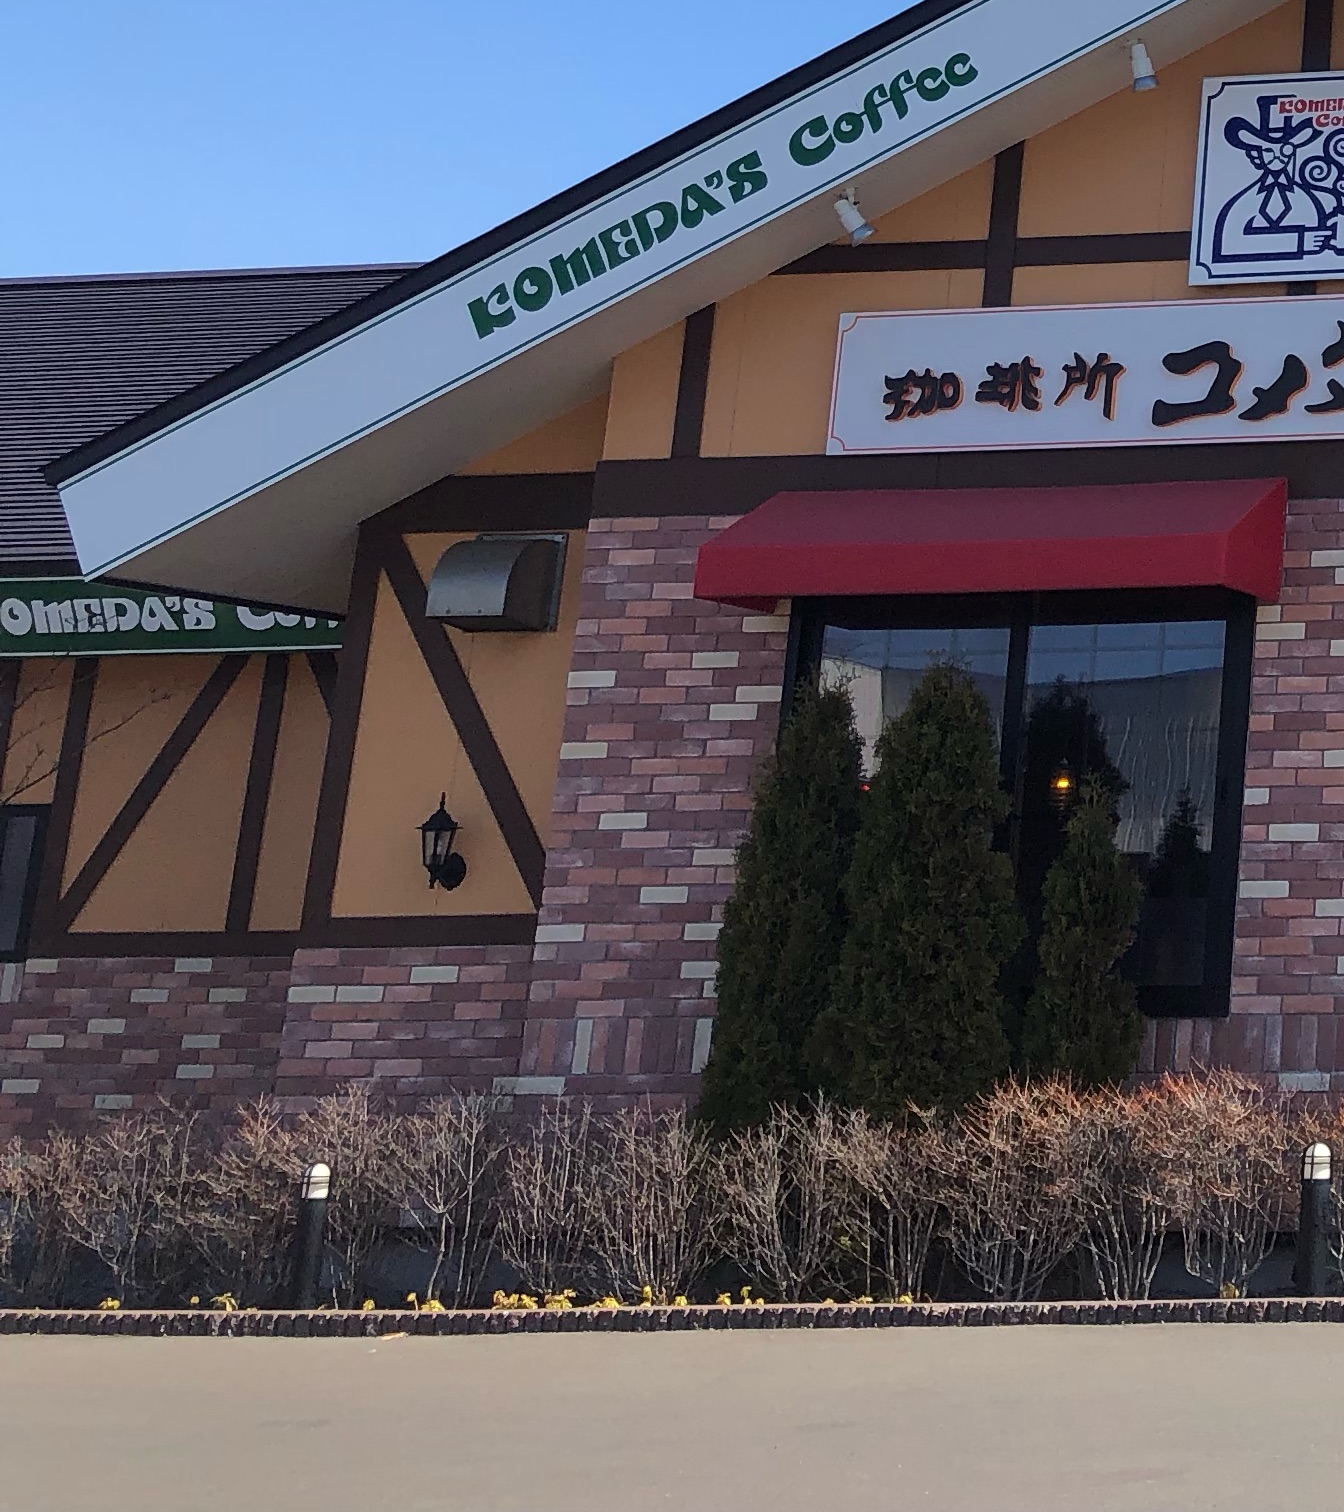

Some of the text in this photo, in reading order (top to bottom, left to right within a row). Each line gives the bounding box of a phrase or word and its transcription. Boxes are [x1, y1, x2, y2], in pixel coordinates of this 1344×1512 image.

[466, 51, 979, 340] KOMEDA'S Coffee
[0, 596, 216, 636] OMEDA'S
